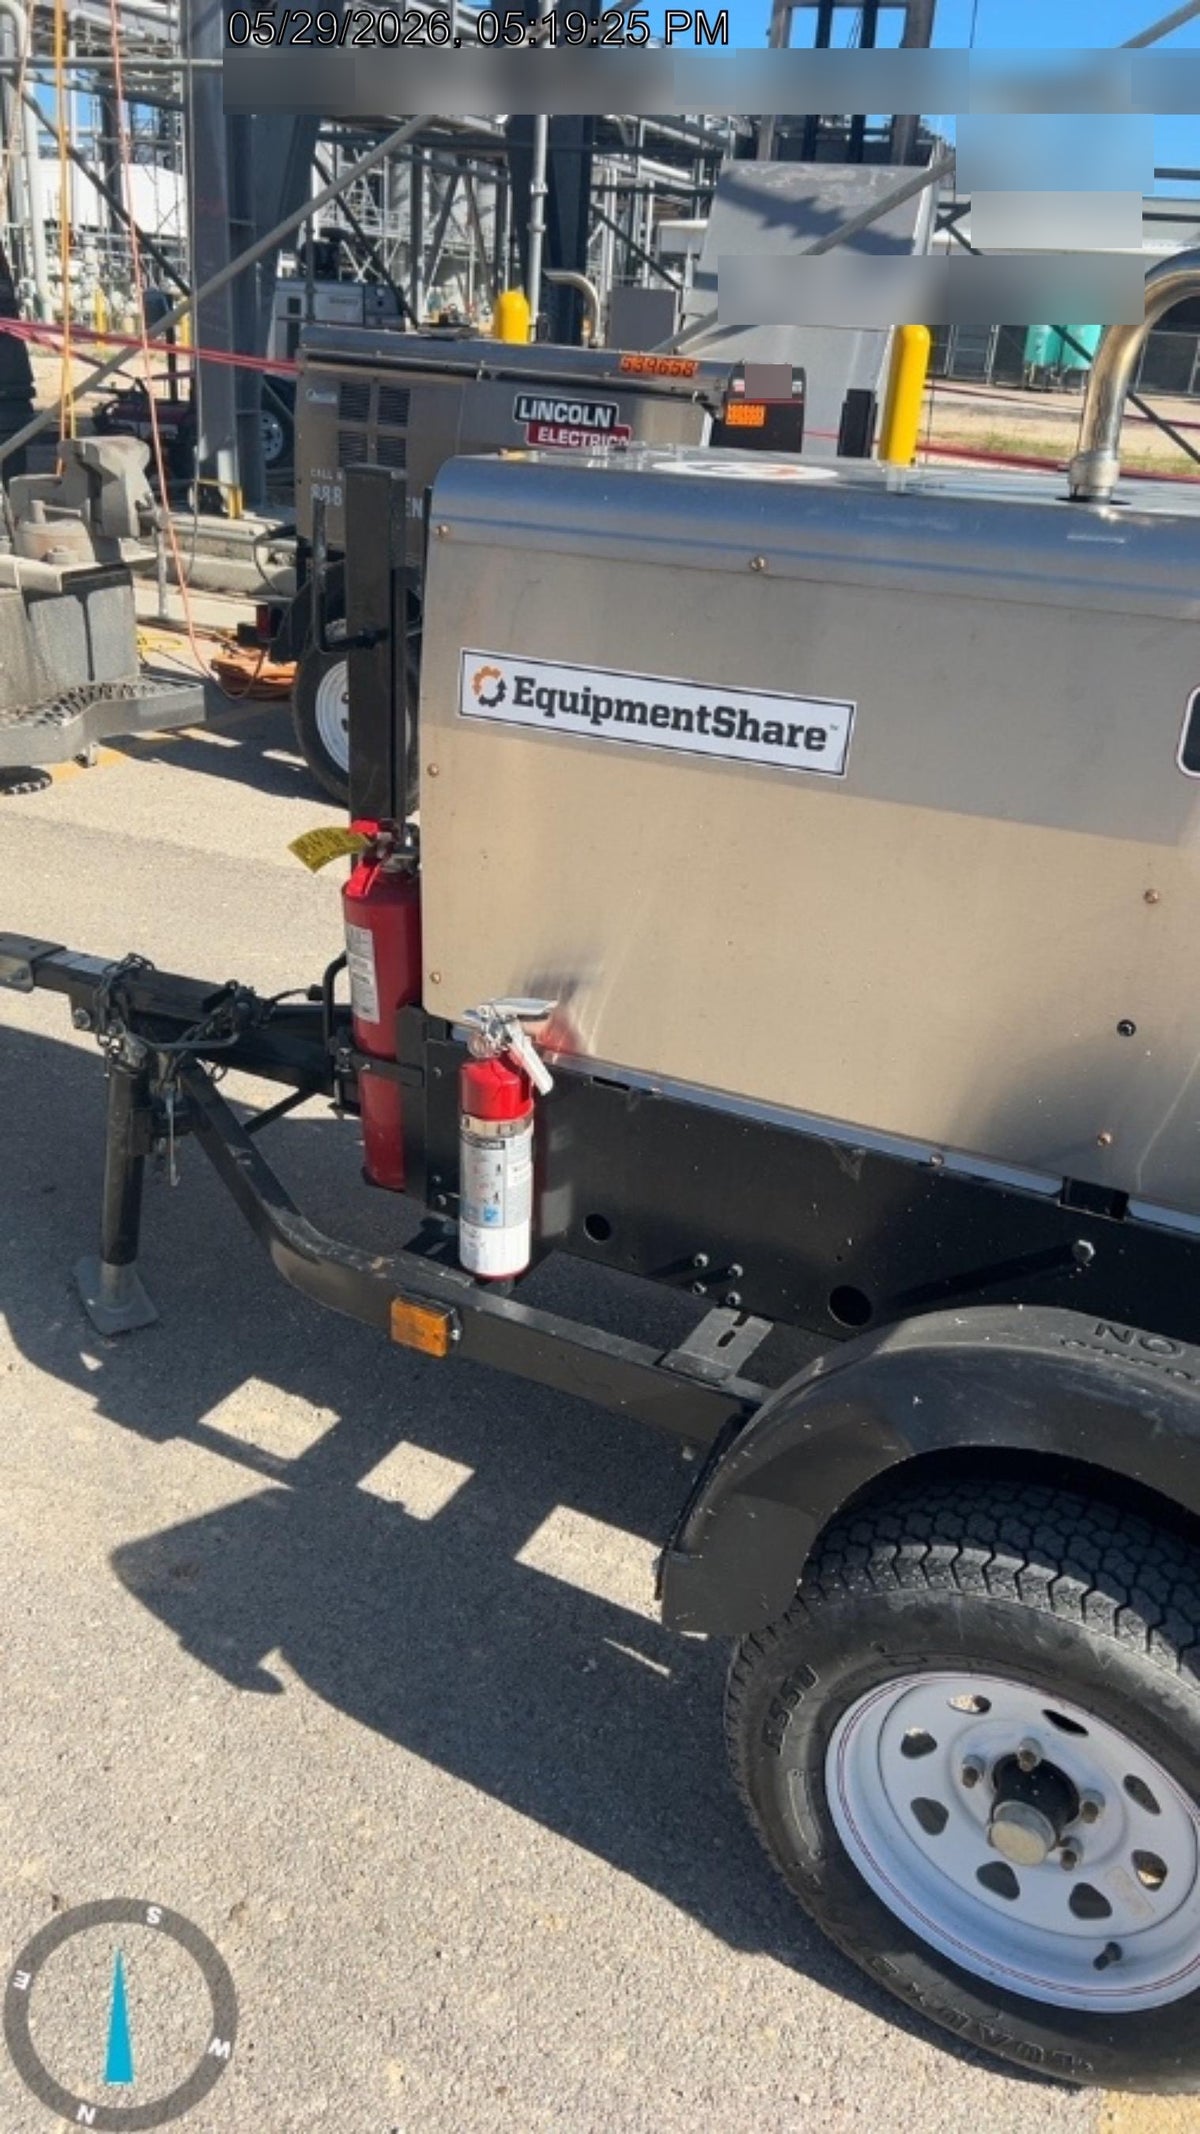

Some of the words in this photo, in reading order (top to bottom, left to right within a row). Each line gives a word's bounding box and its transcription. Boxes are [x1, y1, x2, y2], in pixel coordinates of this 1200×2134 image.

[518, 397, 612, 429] LINCOLN
[512, 675, 828, 752] EquipmentShare
[1094, 1321, 1186, 1359] NO
